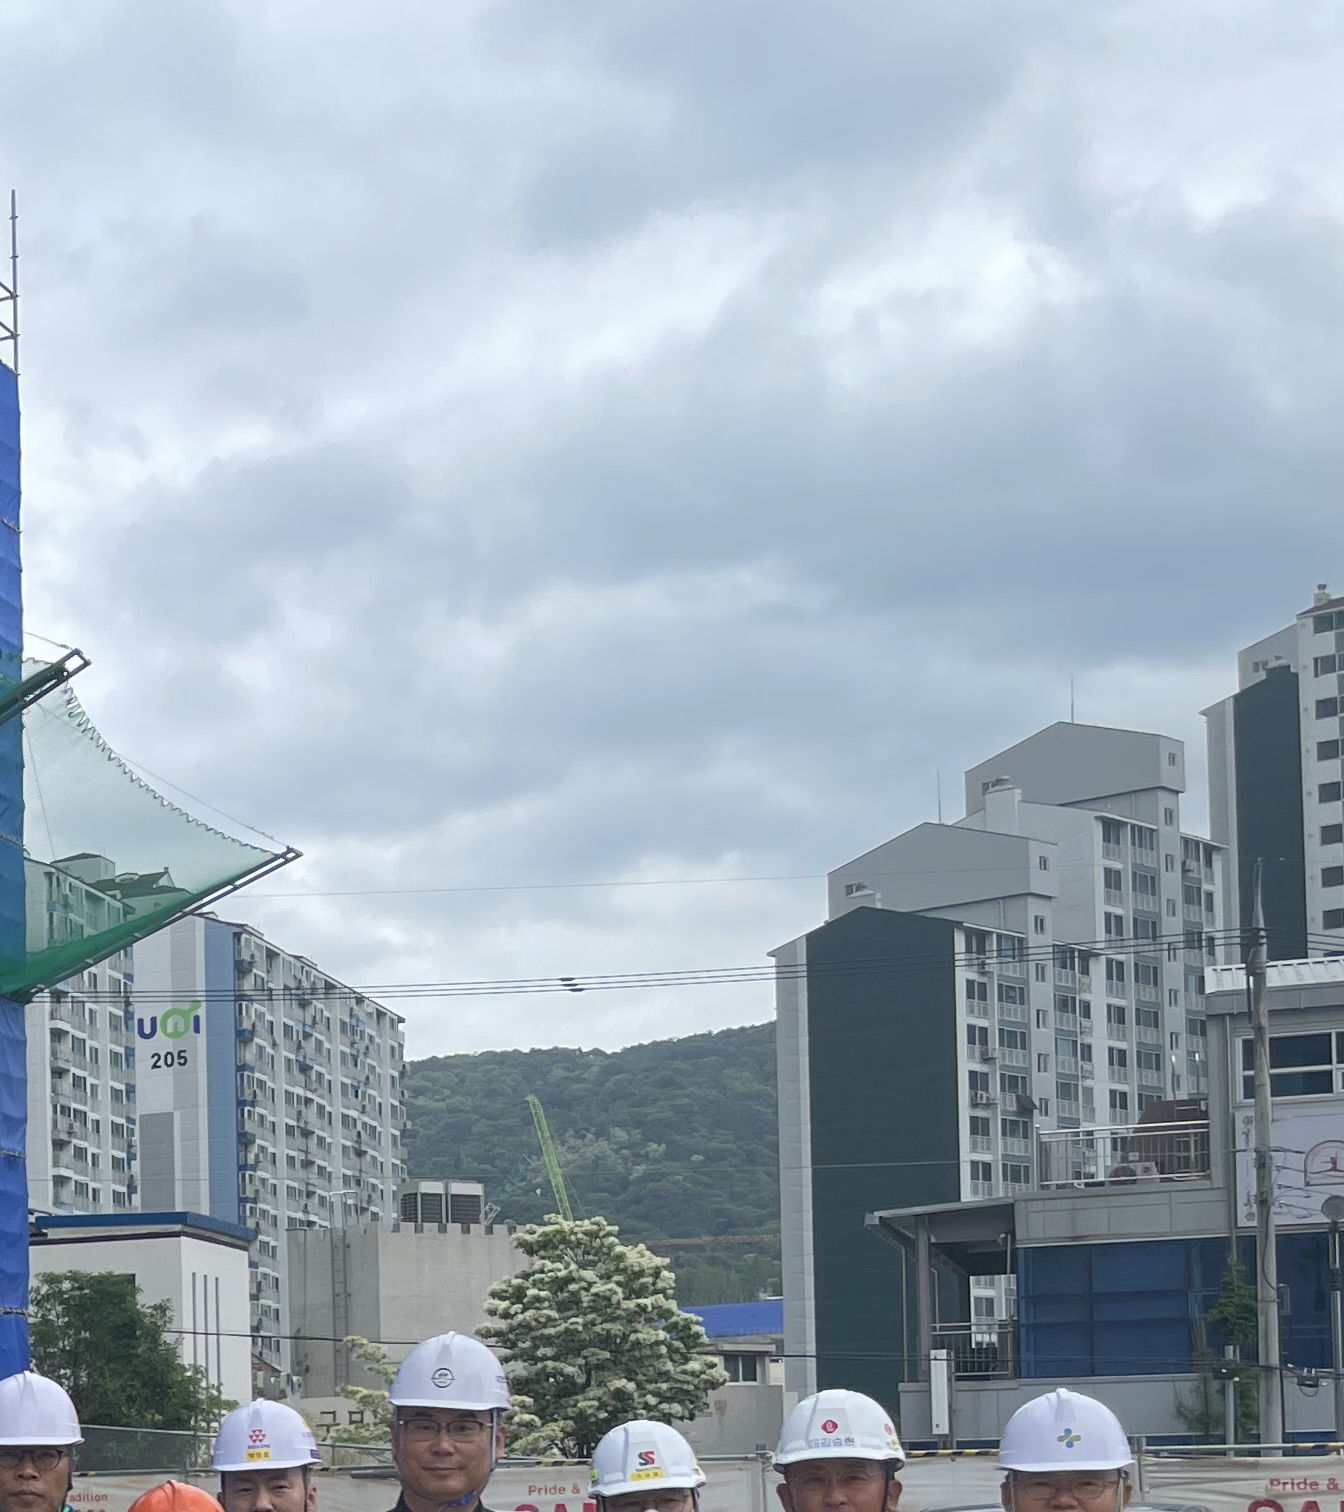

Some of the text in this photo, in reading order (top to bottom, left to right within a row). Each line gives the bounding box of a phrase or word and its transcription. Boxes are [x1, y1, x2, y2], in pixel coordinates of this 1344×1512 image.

[151, 1049, 188, 1070] 205
[528, 1484, 566, 1496] Pride
[1269, 1477, 1319, 1491] Pride
